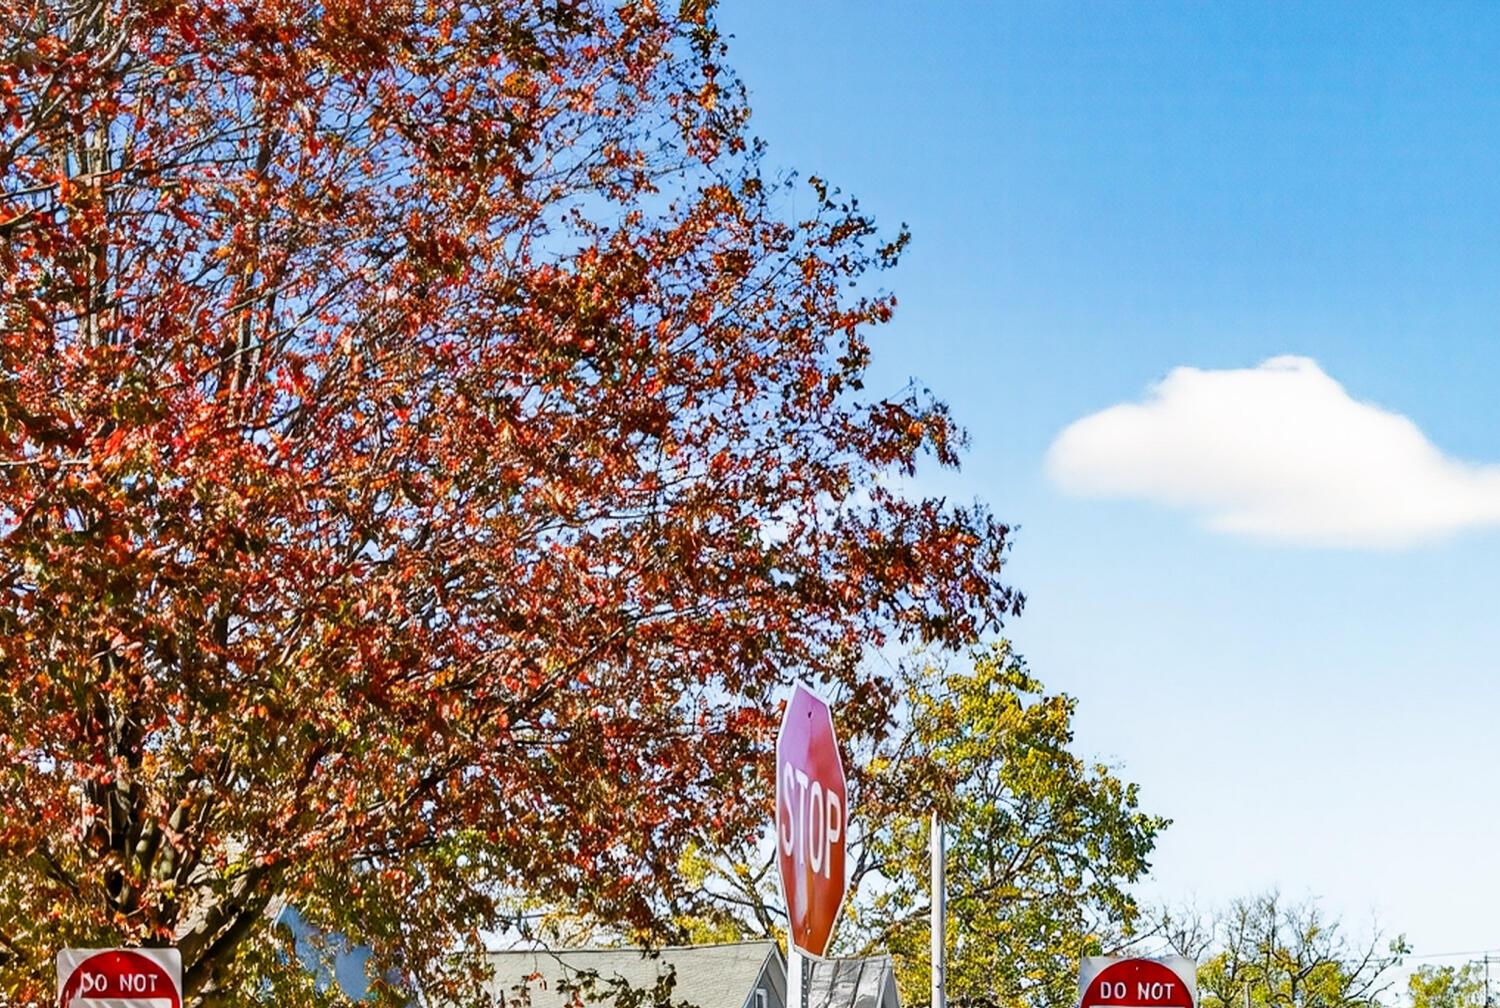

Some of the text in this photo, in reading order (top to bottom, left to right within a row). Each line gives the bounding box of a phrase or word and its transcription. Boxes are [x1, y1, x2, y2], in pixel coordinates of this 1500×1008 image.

[781, 761, 841, 879] STOP
[80, 972, 158, 992] DO NOT
[1100, 981, 1175, 1000] DO NOT
